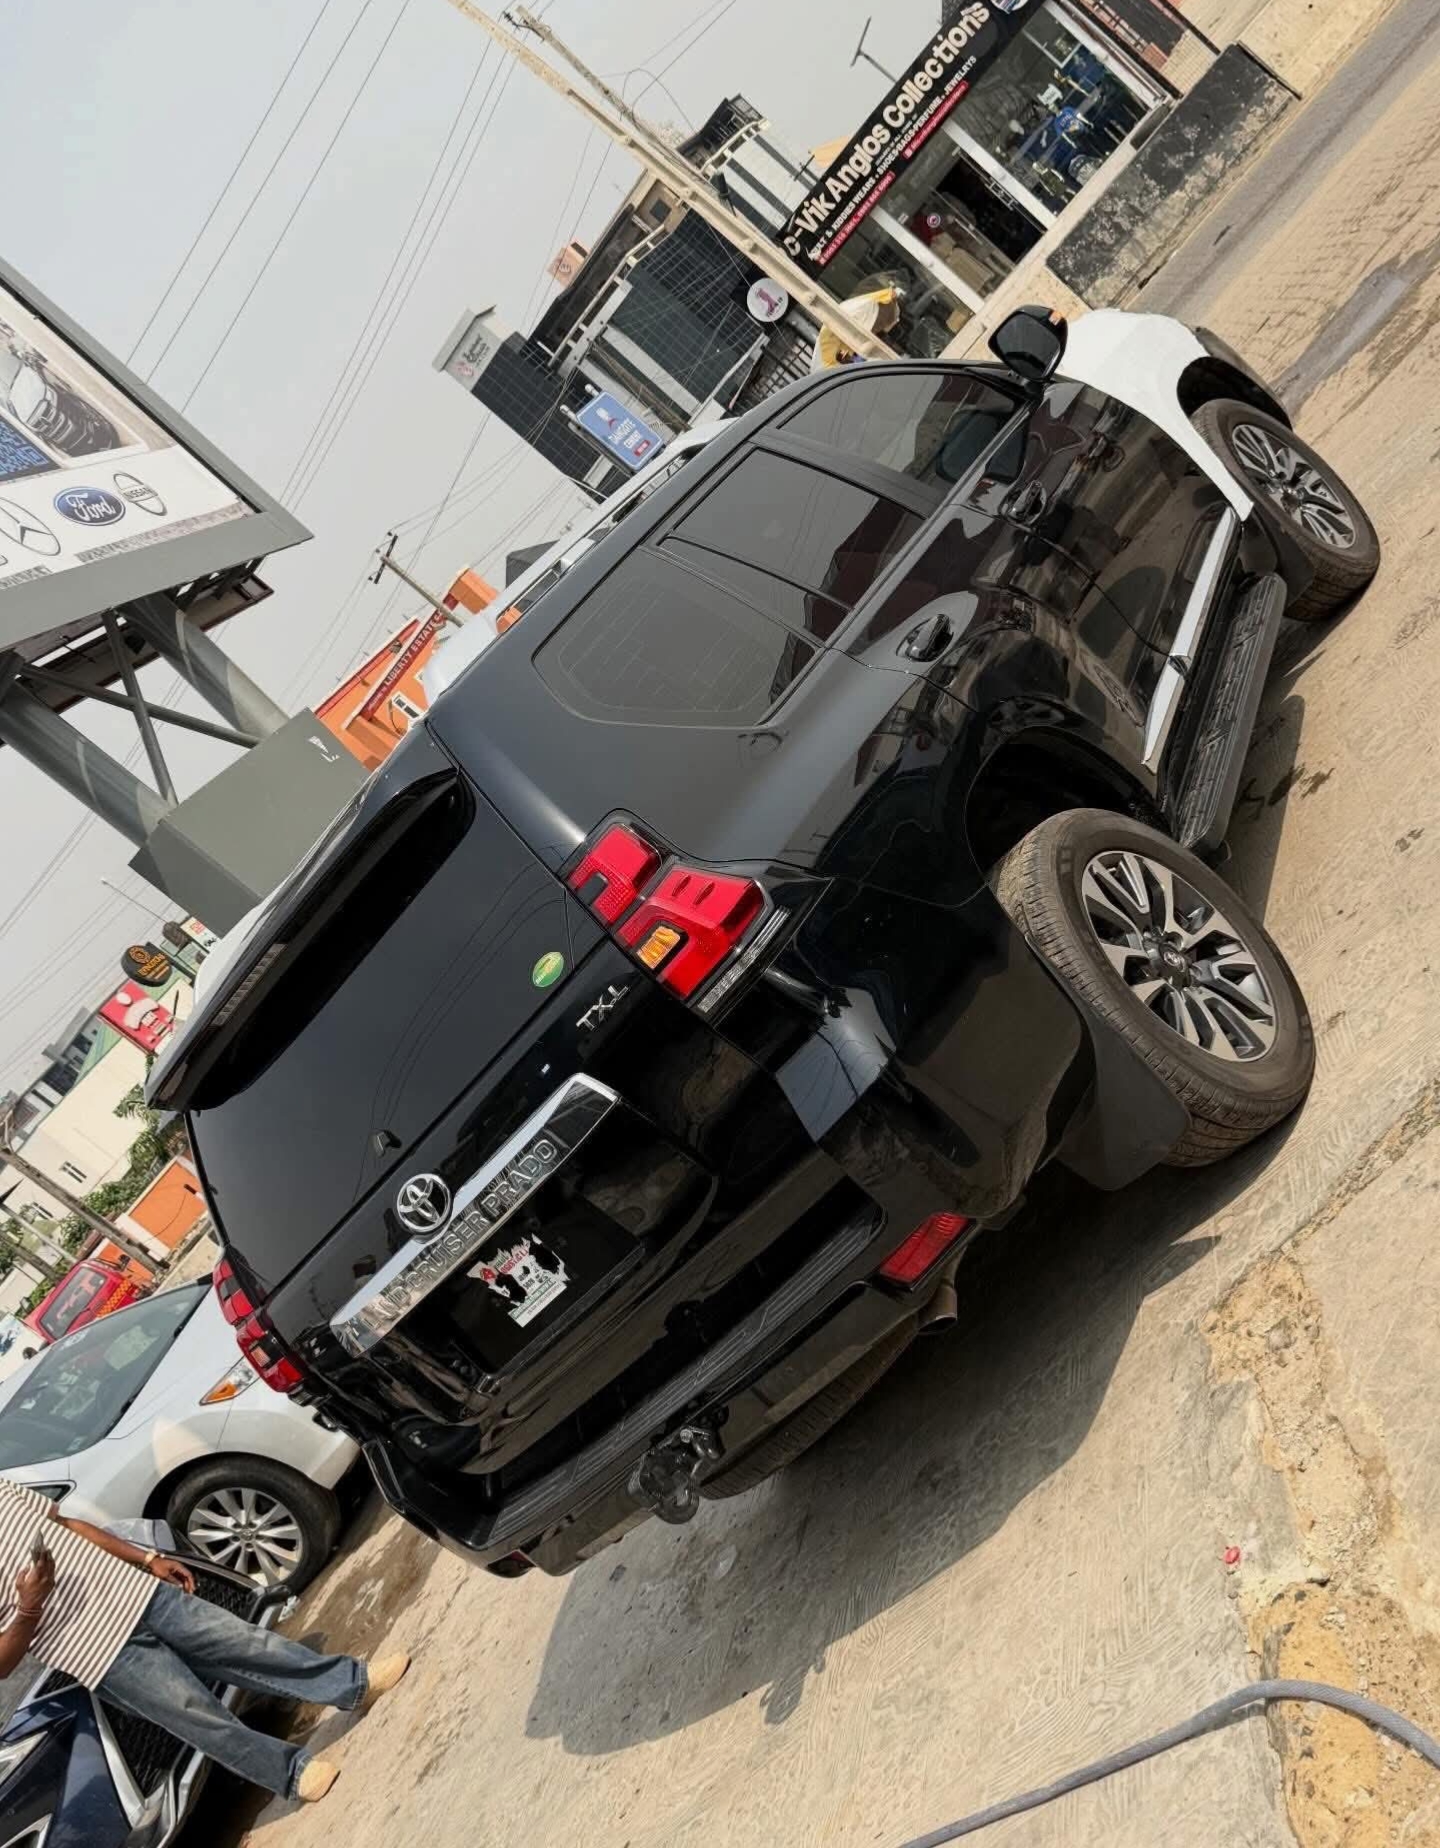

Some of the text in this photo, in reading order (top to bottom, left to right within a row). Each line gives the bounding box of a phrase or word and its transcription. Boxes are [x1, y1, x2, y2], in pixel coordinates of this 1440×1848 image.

[825, 123, 890, 202] Anglos
[882, 2, 989, 127] Collections
[831, 201, 856, 230] KIDDIES
[853, 177, 876, 203] WEARS
[943, 55, 976, 95] JEWELRYS
[66, 493, 116, 521] Ford
[384, 620, 437, 687] LIBERTY ESTATE
[405, 1210, 490, 1289] CRUISER
[481, 1138, 557, 1217] PRADO
